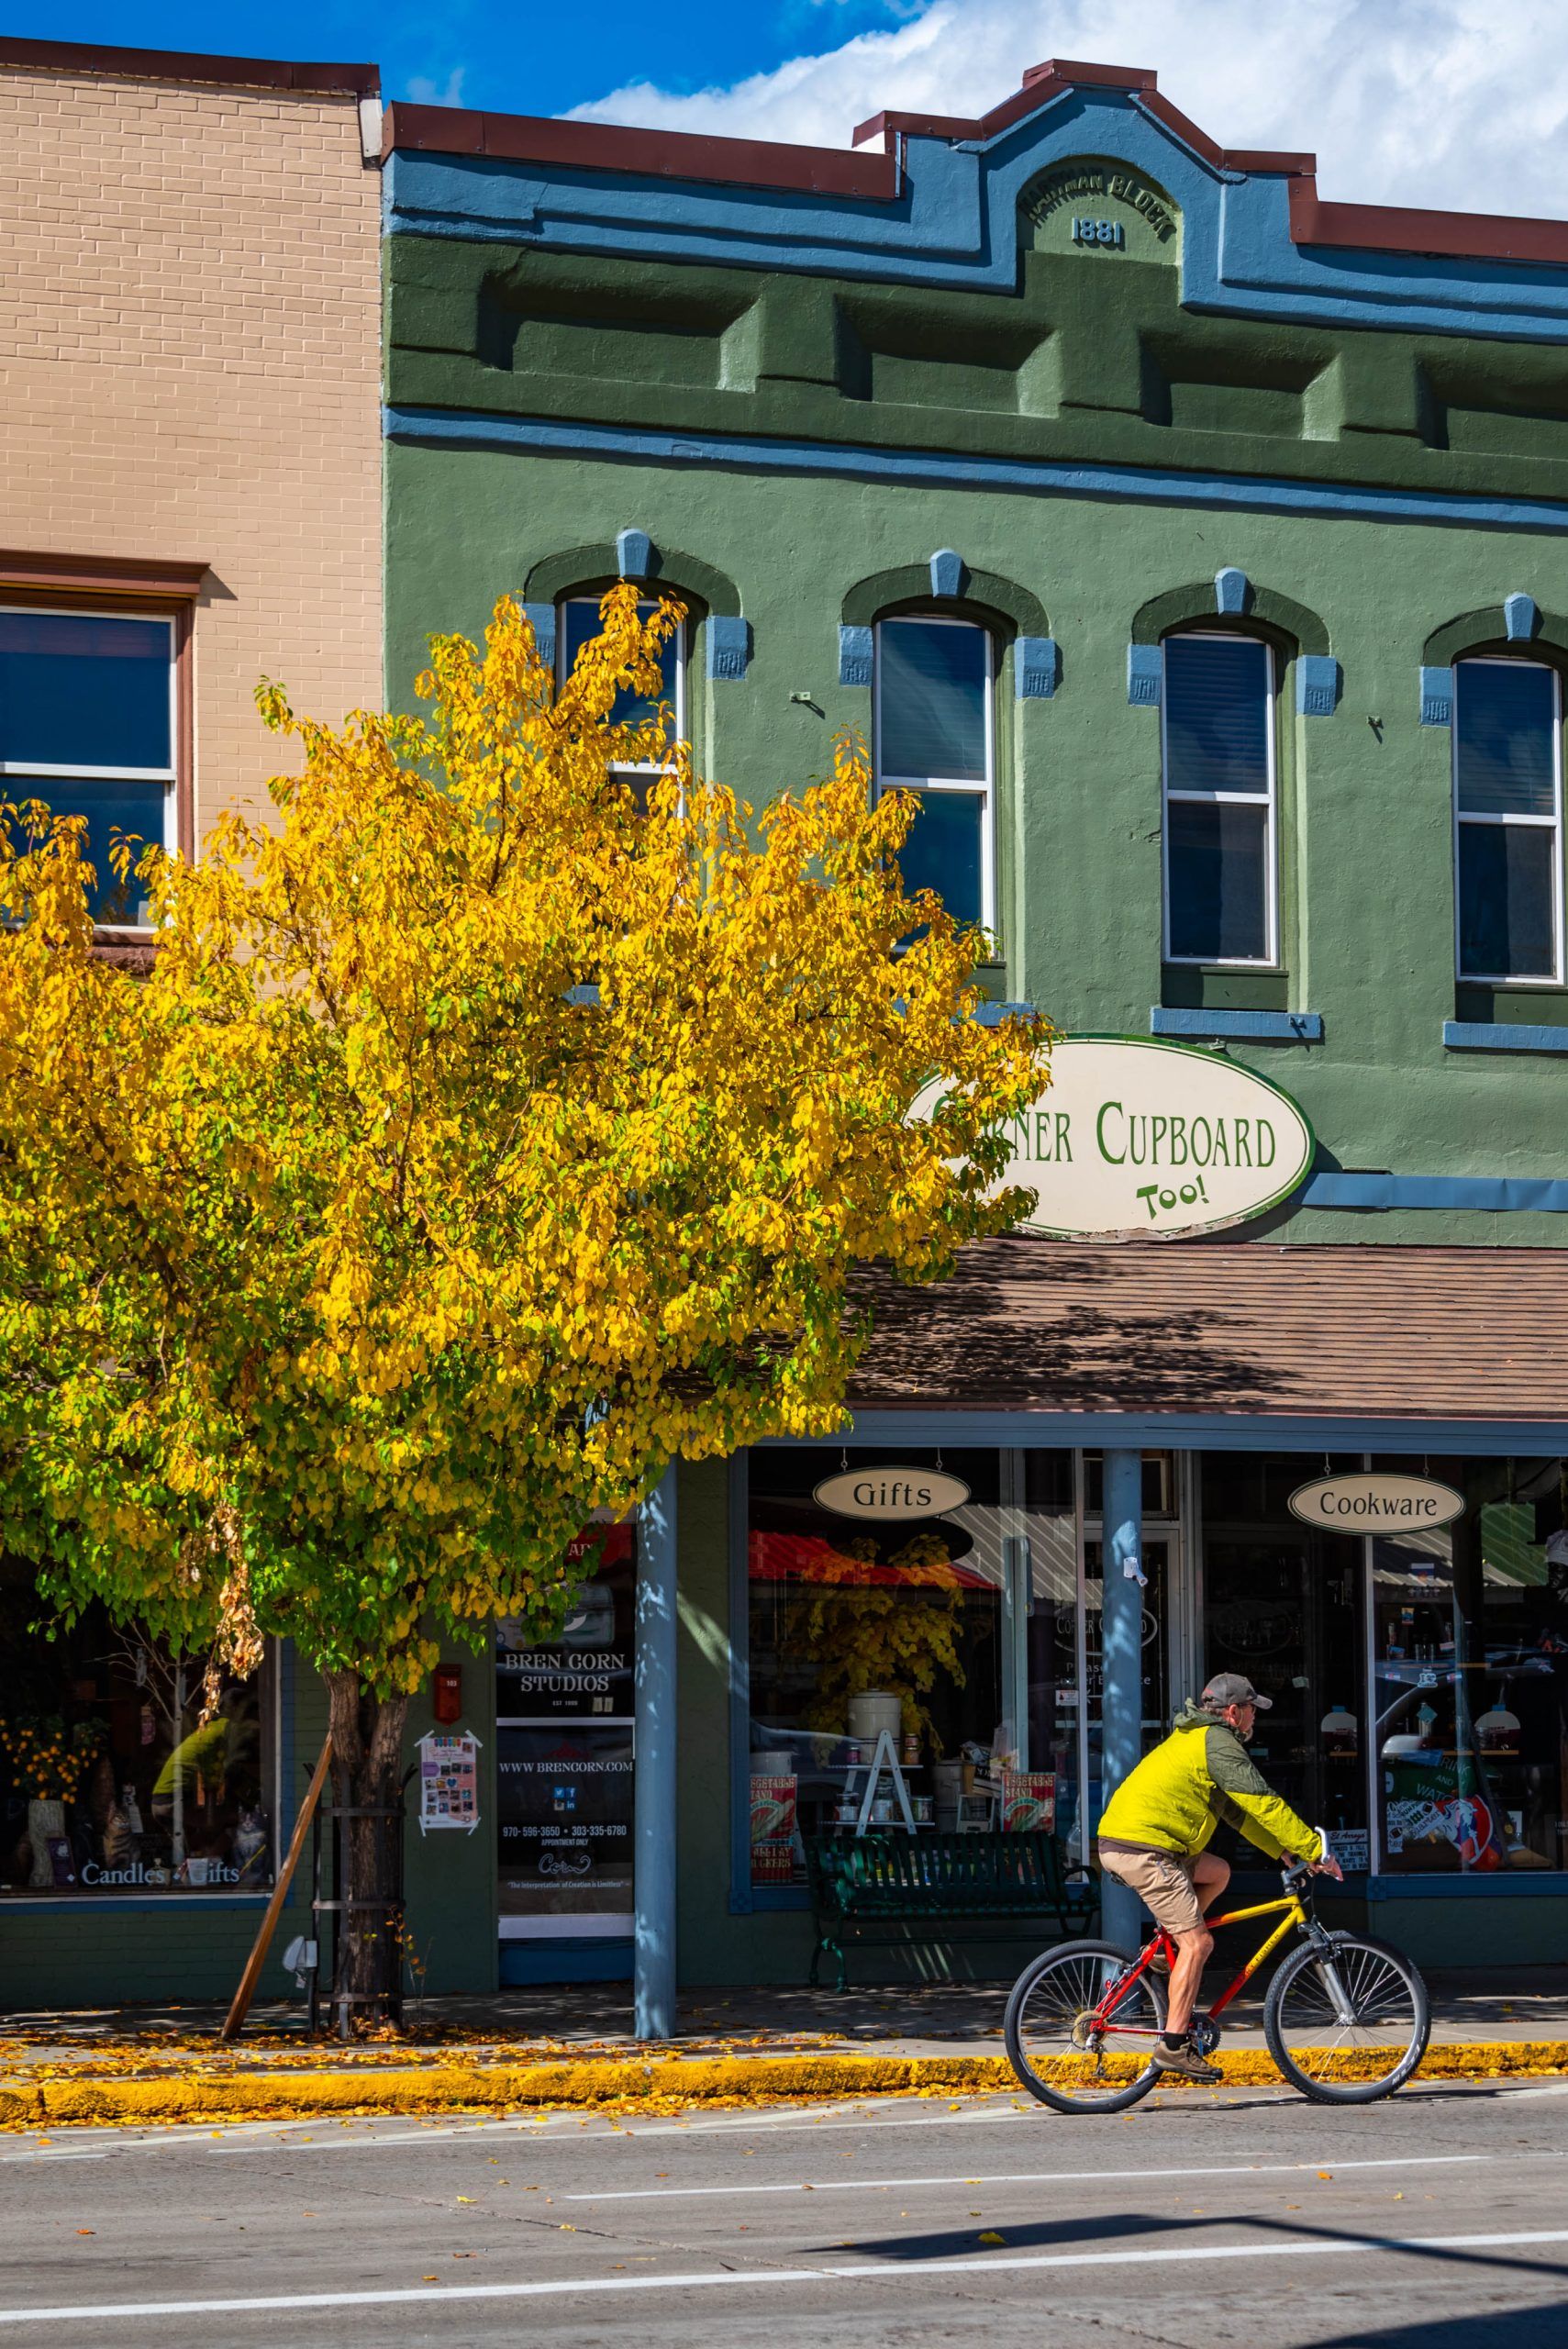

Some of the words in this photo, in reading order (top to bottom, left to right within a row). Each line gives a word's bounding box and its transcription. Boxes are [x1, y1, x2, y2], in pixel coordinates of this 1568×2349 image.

[1109, 174, 1175, 239] BLOCK
[1072, 217, 1121, 244] 1881
[1095, 1101, 1275, 1168] CUPBOARD
[853, 1482, 932, 1507] Gifts
[1319, 1483, 1438, 1516] Cookware
[506, 1653, 561, 1670] BREN
[568, 1653, 625, 1669] CORN
[520, 1675, 609, 1692] STUDIOS
[751, 1777, 795, 1789] EGETABLE
[1435, 1774, 1454, 1786] AND
[81, 1862, 165, 1885] Candles
